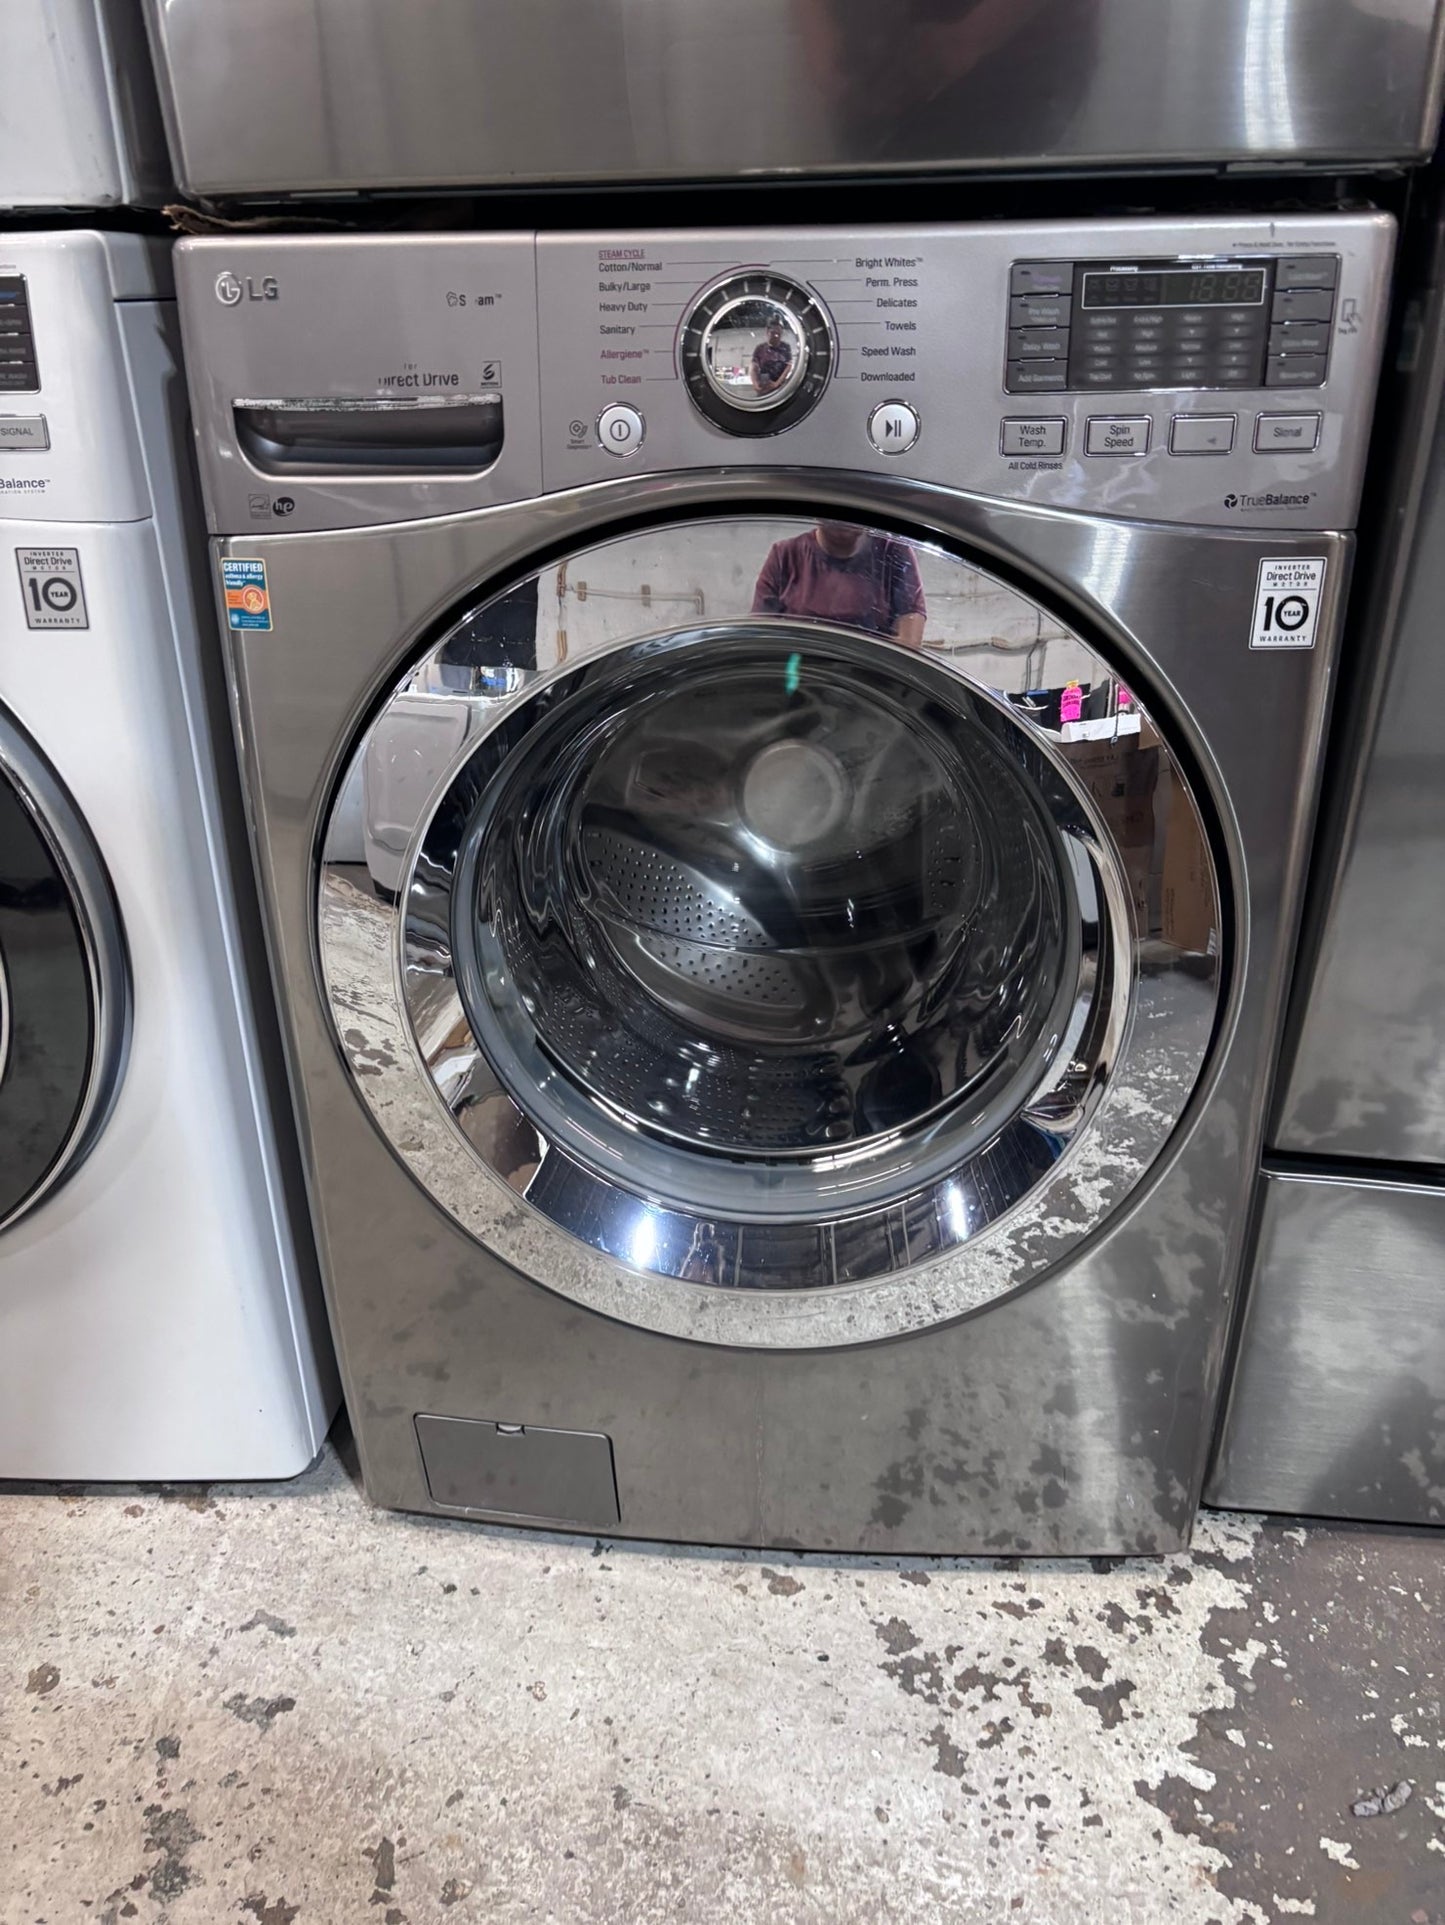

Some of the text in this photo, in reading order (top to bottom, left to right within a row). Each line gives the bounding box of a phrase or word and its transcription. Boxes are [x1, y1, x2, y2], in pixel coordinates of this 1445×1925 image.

[599, 262, 662, 272] Cotton/Normal
[855, 258, 883, 269] Bright
[599, 282, 651, 292] Bulky/Large
[866, 277, 918, 287] Perm. Press
[246, 275, 280, 302] LG
[599, 302, 648, 312] Heavy Duty
[876, 298, 918, 308] Delicates
[600, 325, 636, 335] Sanitary
[885, 321, 917, 330] Towels
[861, 346, 916, 357] Speed Wash
[423, 373, 459, 386] Drive
[601, 375, 642, 384] Tub Clean
[861, 372, 916, 382] Downloaded
[1019, 425, 1046, 435] Wash
[1110, 425, 1131, 437] Spin
[1019, 438, 1046, 448] Temp.
[1104, 437, 1134, 448] Speed
[1008, 461, 1063, 470] All Cold Rinses
[24, 556, 72, 566] Direct Drive
[223, 562, 263, 572] CERTIFIED
[1266, 571, 1316, 580] Direct Drive
[29, 577, 78, 612] 10
[1263, 595, 1309, 631] 10
